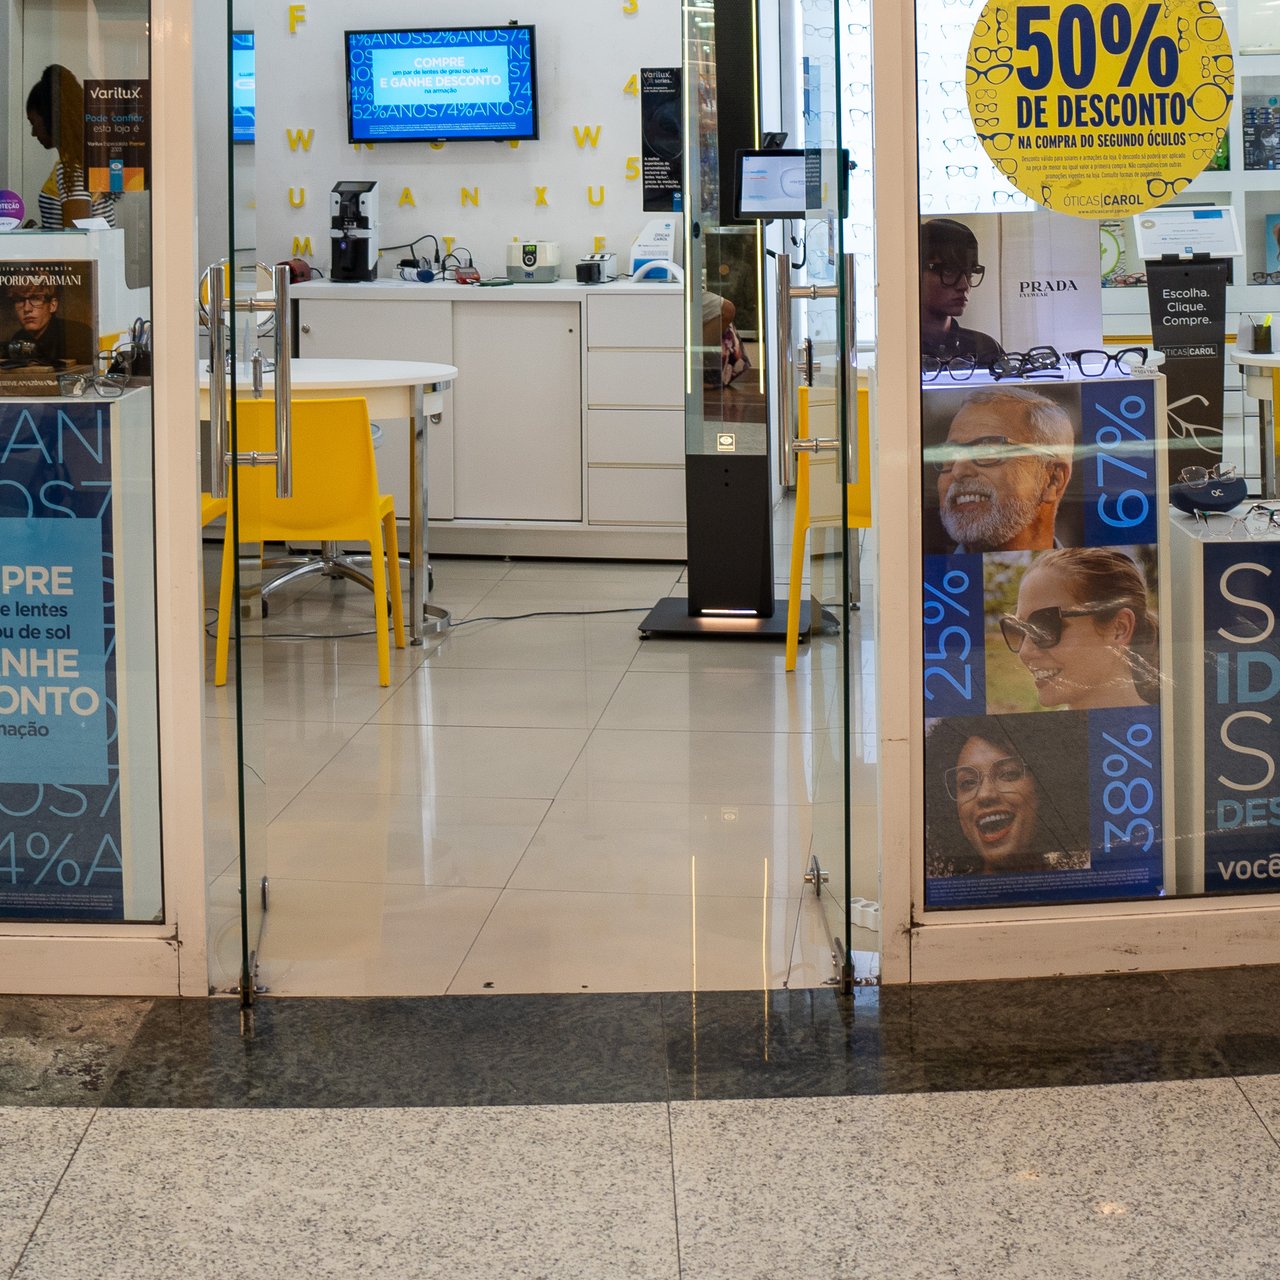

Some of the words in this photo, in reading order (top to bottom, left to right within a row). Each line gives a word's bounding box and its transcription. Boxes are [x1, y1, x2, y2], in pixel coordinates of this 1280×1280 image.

[1016, 2, 1179, 90] 50%
[414, 57, 465, 68] COMPRE
[380, 78, 388, 88] E
[390, 77, 433, 88] GANHE
[435, 75, 502, 87] DESCONTO
[623, 73, 639, 97] 4
[90, 87, 141, 99] Varilux
[1017, 95, 1048, 129] DE
[1057, 92, 1186, 128] DESCONTO
[1018, 135, 1032, 149] NA
[1035, 134, 1077, 149] COMPRA
[1080, 134, 1094, 148] DO
[1098, 132, 1144, 148] SEGUNDO
[1147, 129, 1186, 146] ÓCULOS
[625, 156, 640, 181] 5
[1103, 194, 1144, 206] CAROL
[1019, 279, 1078, 293] PRADA
[1162, 287, 1210, 299] Escolha.
[1166, 301, 1207, 313] Clique.
[1162, 315, 1212, 327] Compre.
